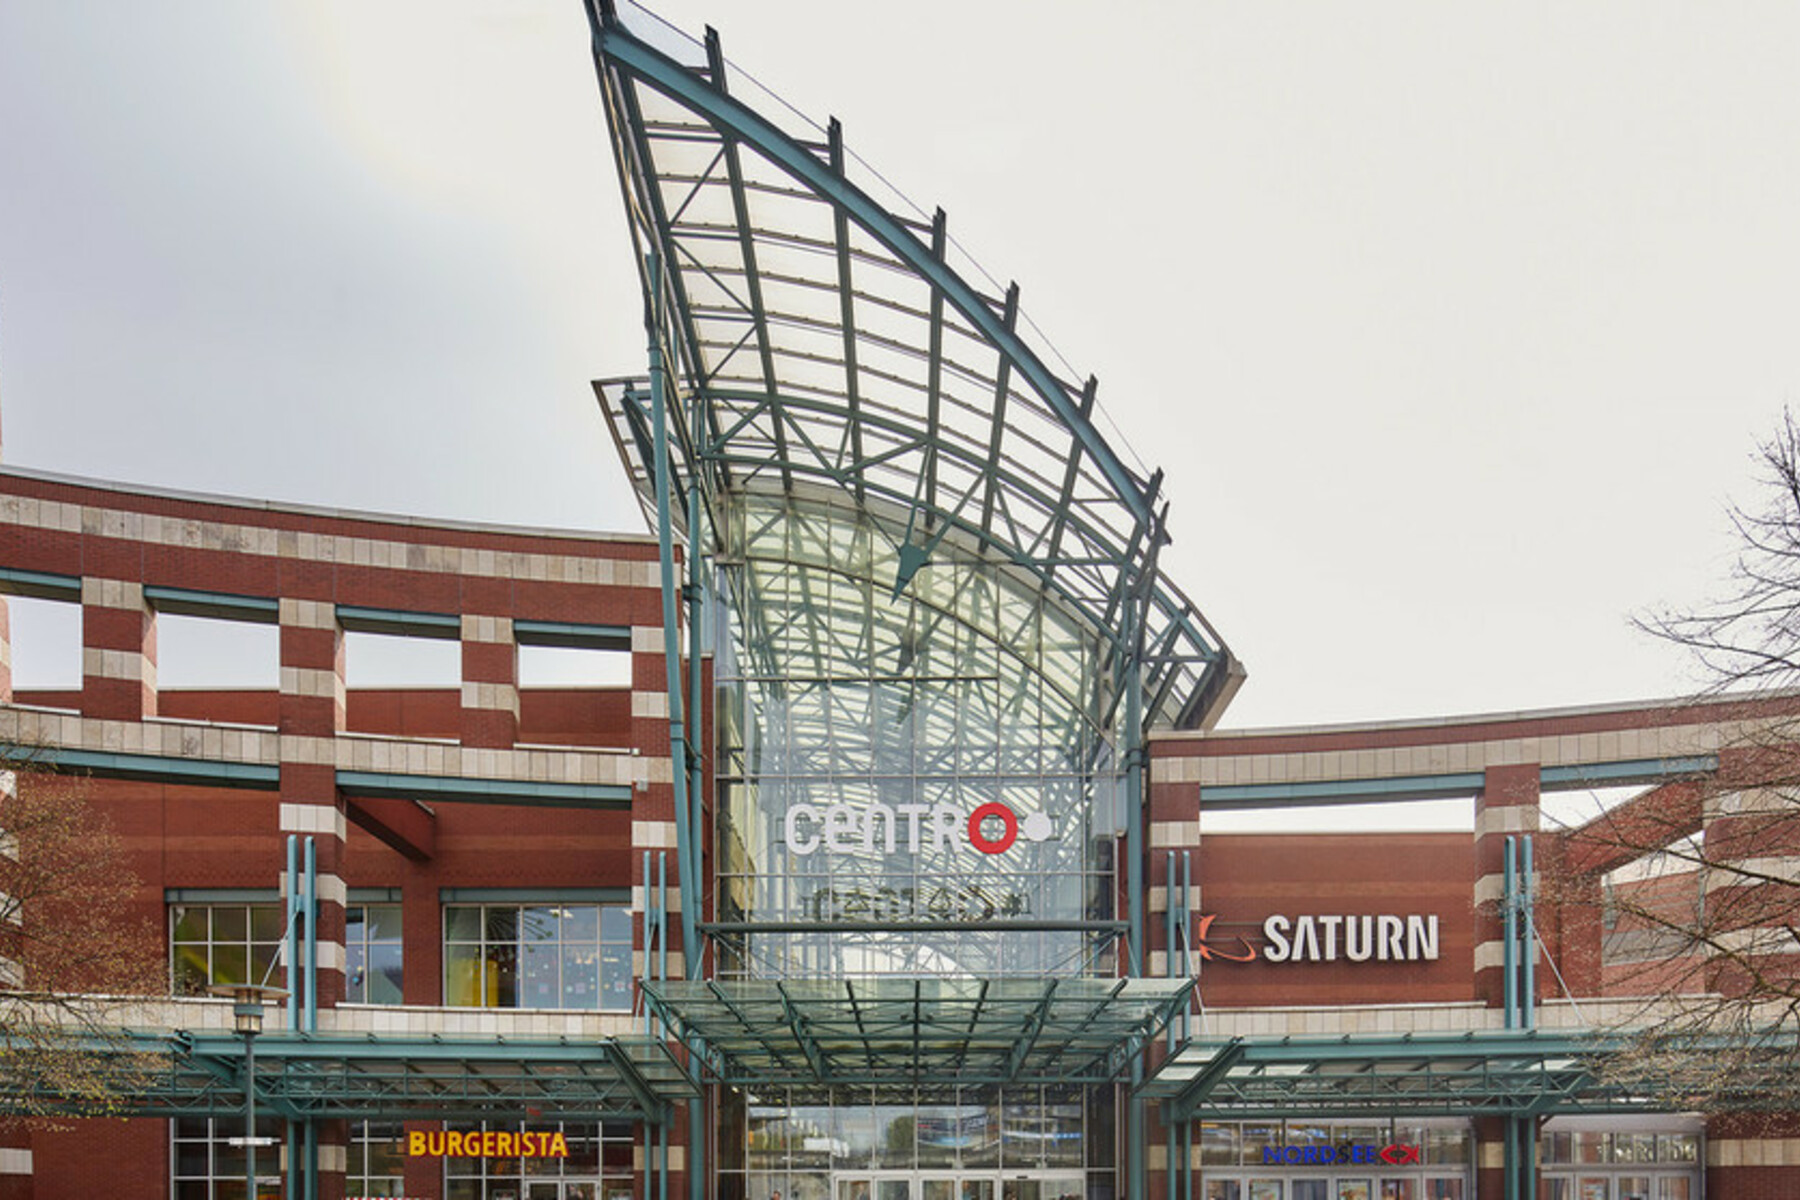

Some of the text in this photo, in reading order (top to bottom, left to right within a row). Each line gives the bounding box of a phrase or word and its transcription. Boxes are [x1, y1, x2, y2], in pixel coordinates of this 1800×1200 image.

[1264, 915, 1438, 961] SATURN
[409, 1131, 568, 1157] BURGERISTA
[1263, 1145, 1376, 1164] NORDSEE
